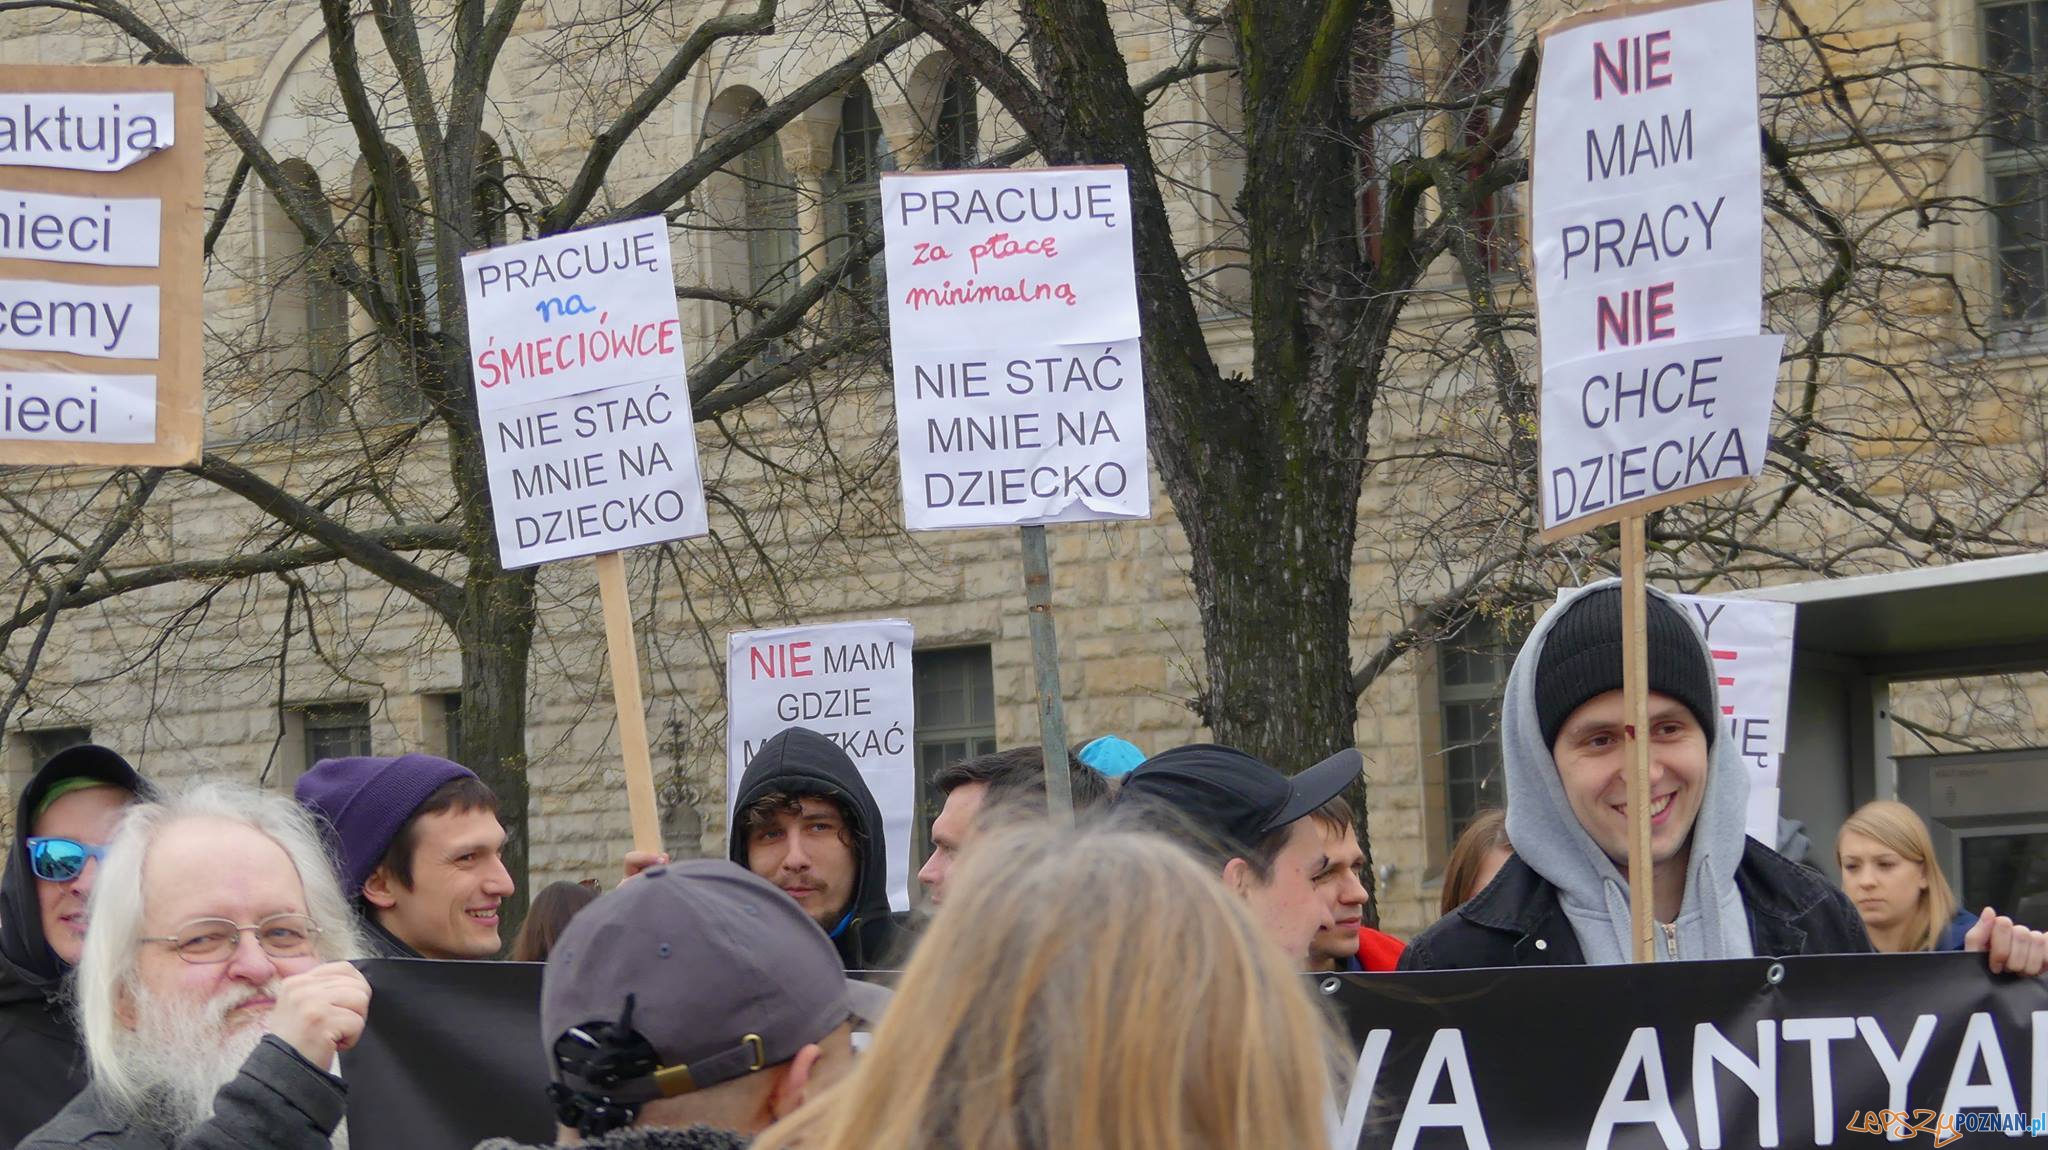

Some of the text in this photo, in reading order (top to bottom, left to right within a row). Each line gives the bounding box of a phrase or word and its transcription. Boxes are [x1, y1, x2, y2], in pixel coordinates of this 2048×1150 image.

[1592, 29, 1674, 101] NIE
[1585, 108, 1694, 183] MAM
[899, 184, 1116, 228] PRACUJĘ
[477, 232, 659, 298] PRACUJĘ
[911, 232, 1058, 275] za płacę
[1561, 196, 1726, 280] PRACY
[535, 294, 597, 323] na
[905, 278, 1077, 311] minimalną
[1596, 281, 1676, 352] NIE
[477, 311, 680, 389] ŚMIECIÓWCE
[914, 347, 1124, 400] NIE STAĆ
[498, 384, 672, 453] NIE STAĆ
[1581, 356, 1723, 429] CHCĘ
[927, 410, 1121, 454] MNIE NA
[512, 442, 674, 500] MNIE NA
[924, 461, 1127, 509] DZIECKO
[1551, 427, 1751, 523] DZIECKA
[514, 489, 685, 549] DZIECKO
[750, 641, 896, 681] NIE MAM
[777, 687, 872, 722] GDZIE
